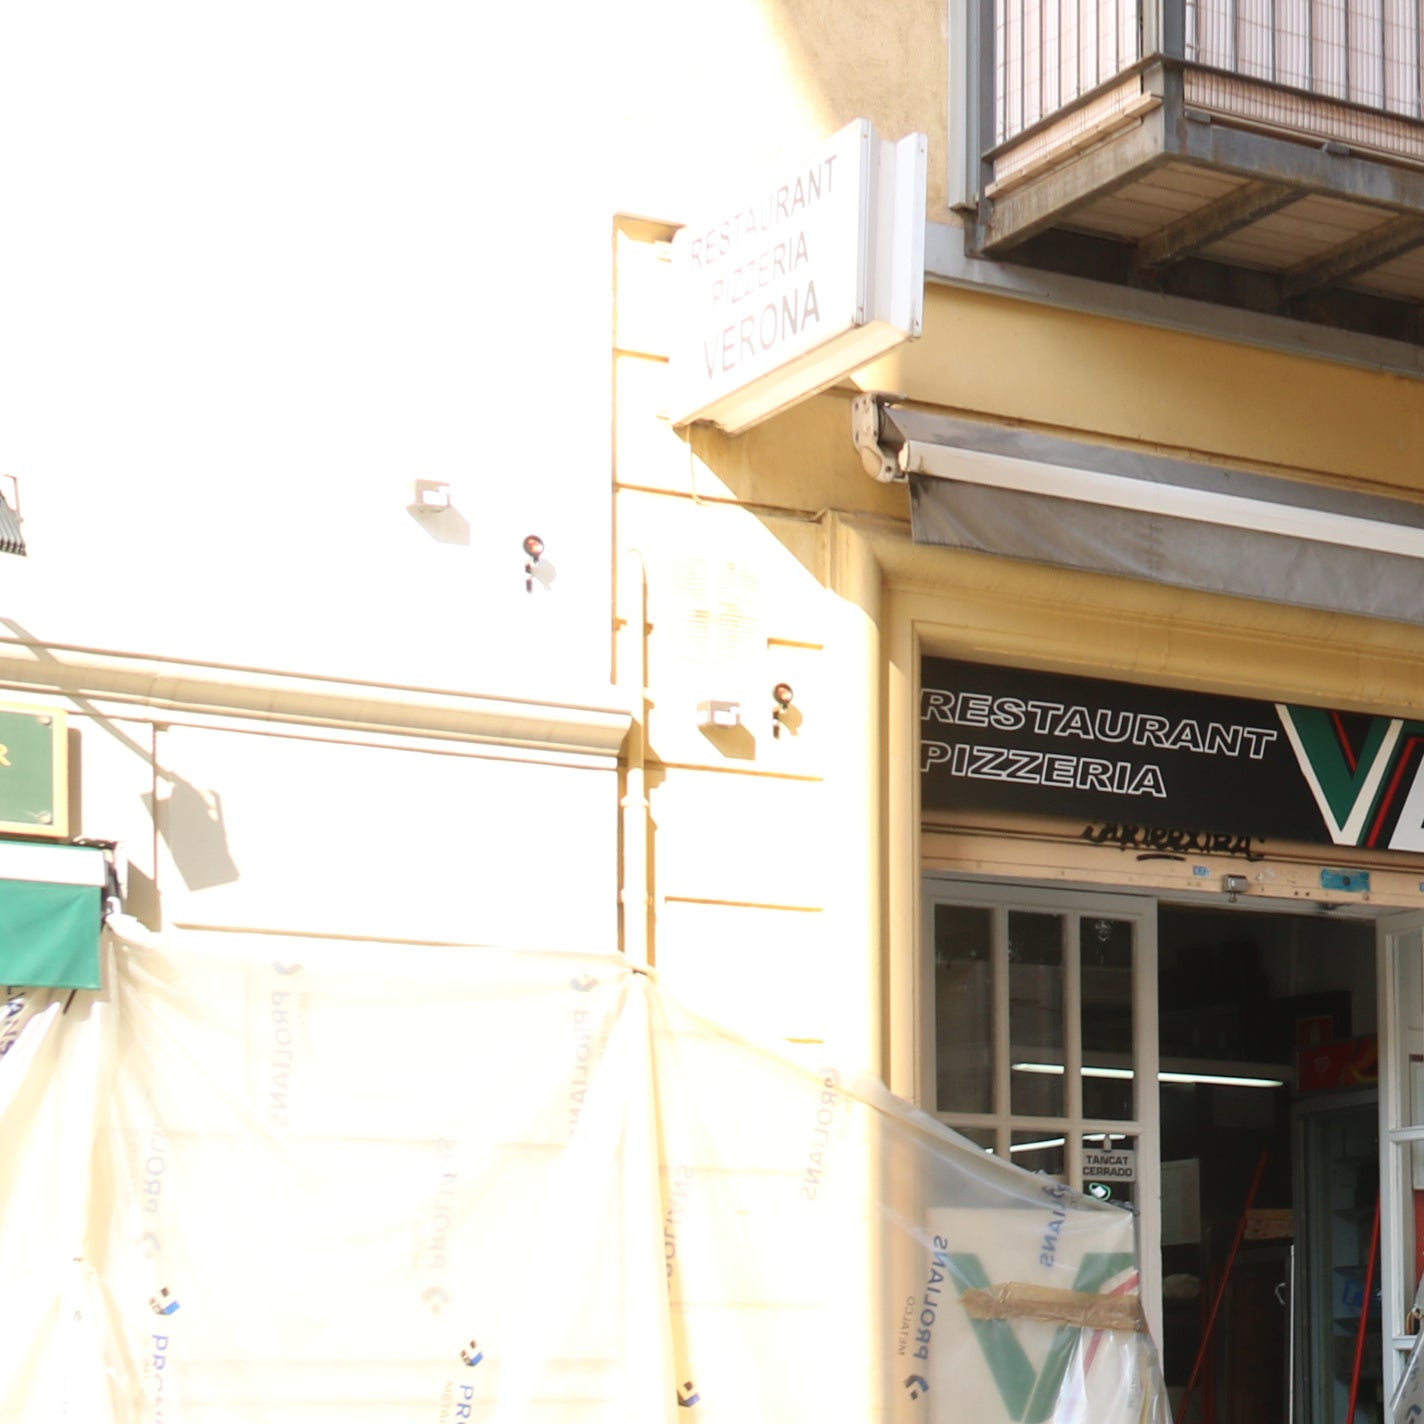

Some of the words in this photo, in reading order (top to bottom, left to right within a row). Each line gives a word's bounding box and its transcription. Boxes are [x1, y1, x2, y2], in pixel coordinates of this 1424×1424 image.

[691, 154, 838, 272] RESTAURANT
[704, 280, 821, 380] VERONA
[920, 687, 1279, 760] RESTAURANT
[920, 740, 1168, 799] PIZZERIA
[1082, 1165, 1134, 1178] CERRADO
[1085, 1154, 1130, 1166] TANCAT
